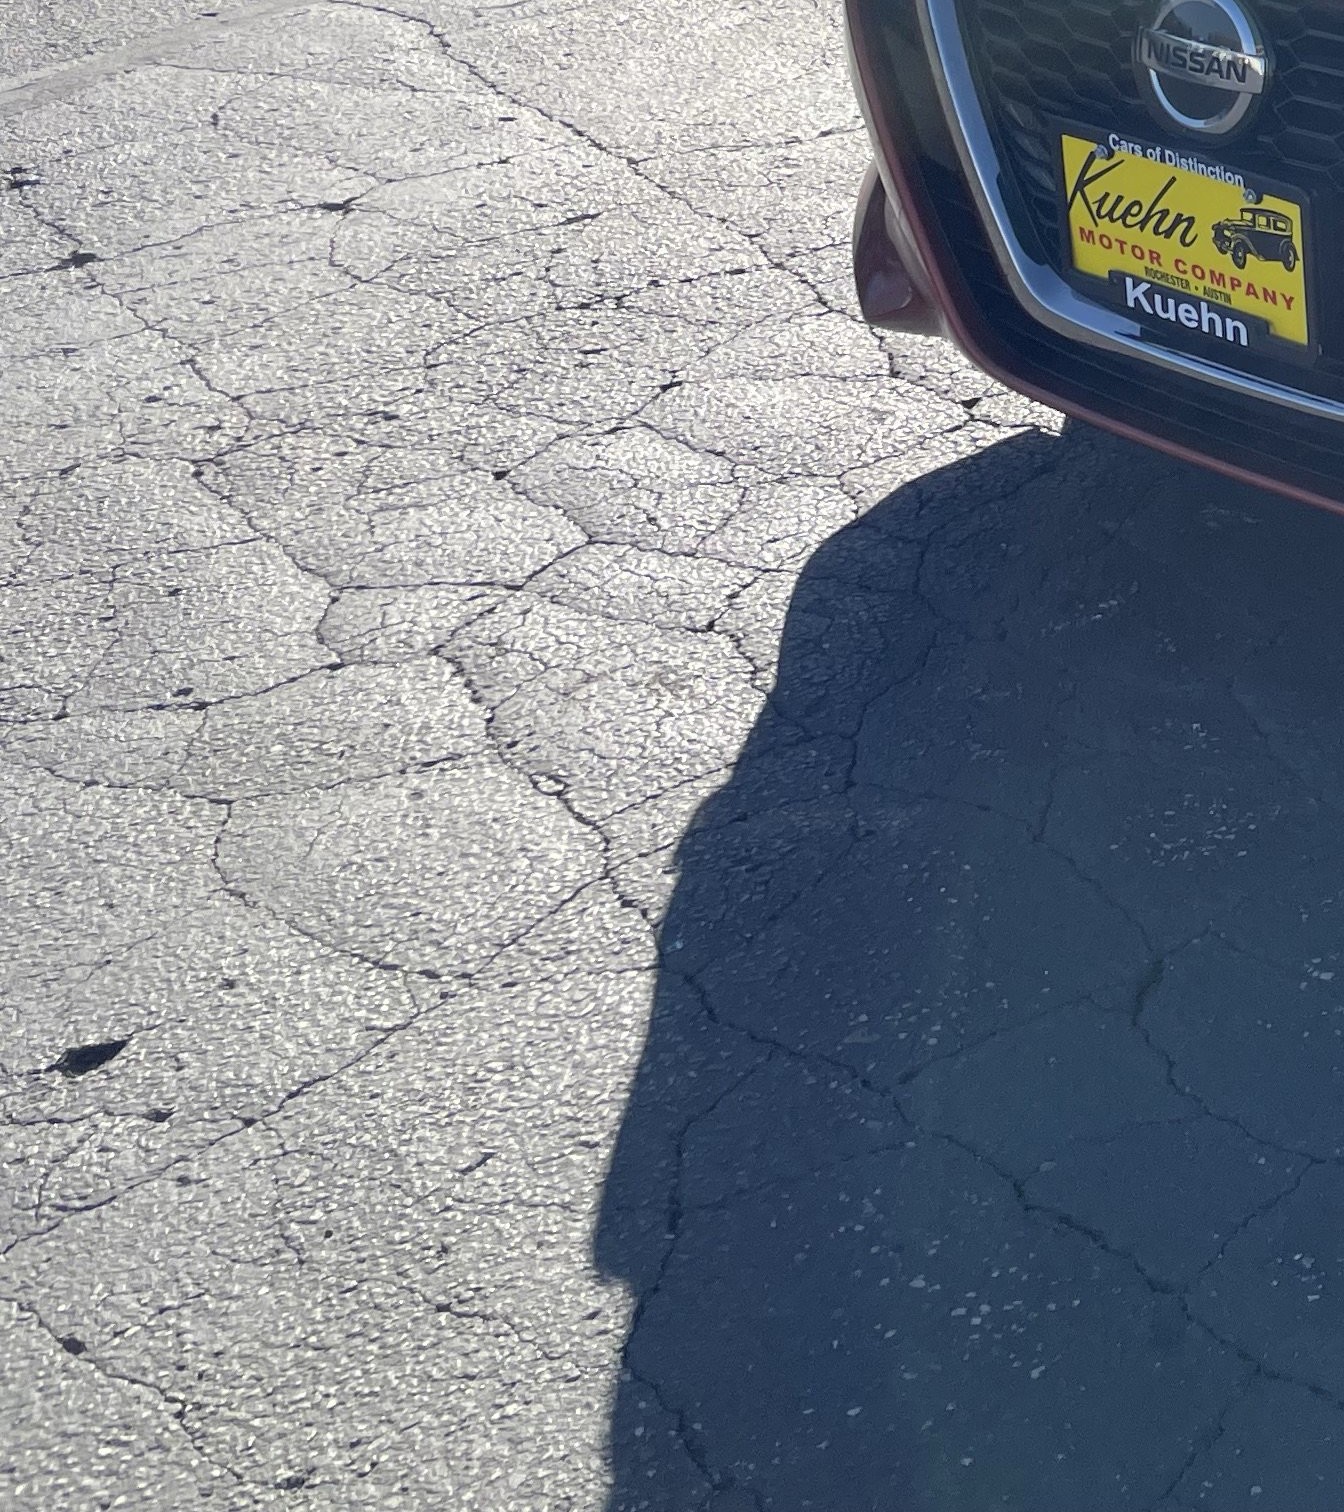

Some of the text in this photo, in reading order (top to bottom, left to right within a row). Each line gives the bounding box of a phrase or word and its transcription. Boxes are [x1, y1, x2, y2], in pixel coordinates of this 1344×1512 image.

[1147, 39, 1248, 84] NISSAN
[1108, 133, 1245, 188] Cars of Distinction
[1067, 151, 1198, 248] Kuehn
[1079, 225, 1296, 311] MOTOR COMPANY
[1144, 266, 1232, 305] ROCHESTER AUSTIN
[1124, 277, 1249, 347] Kuehn
